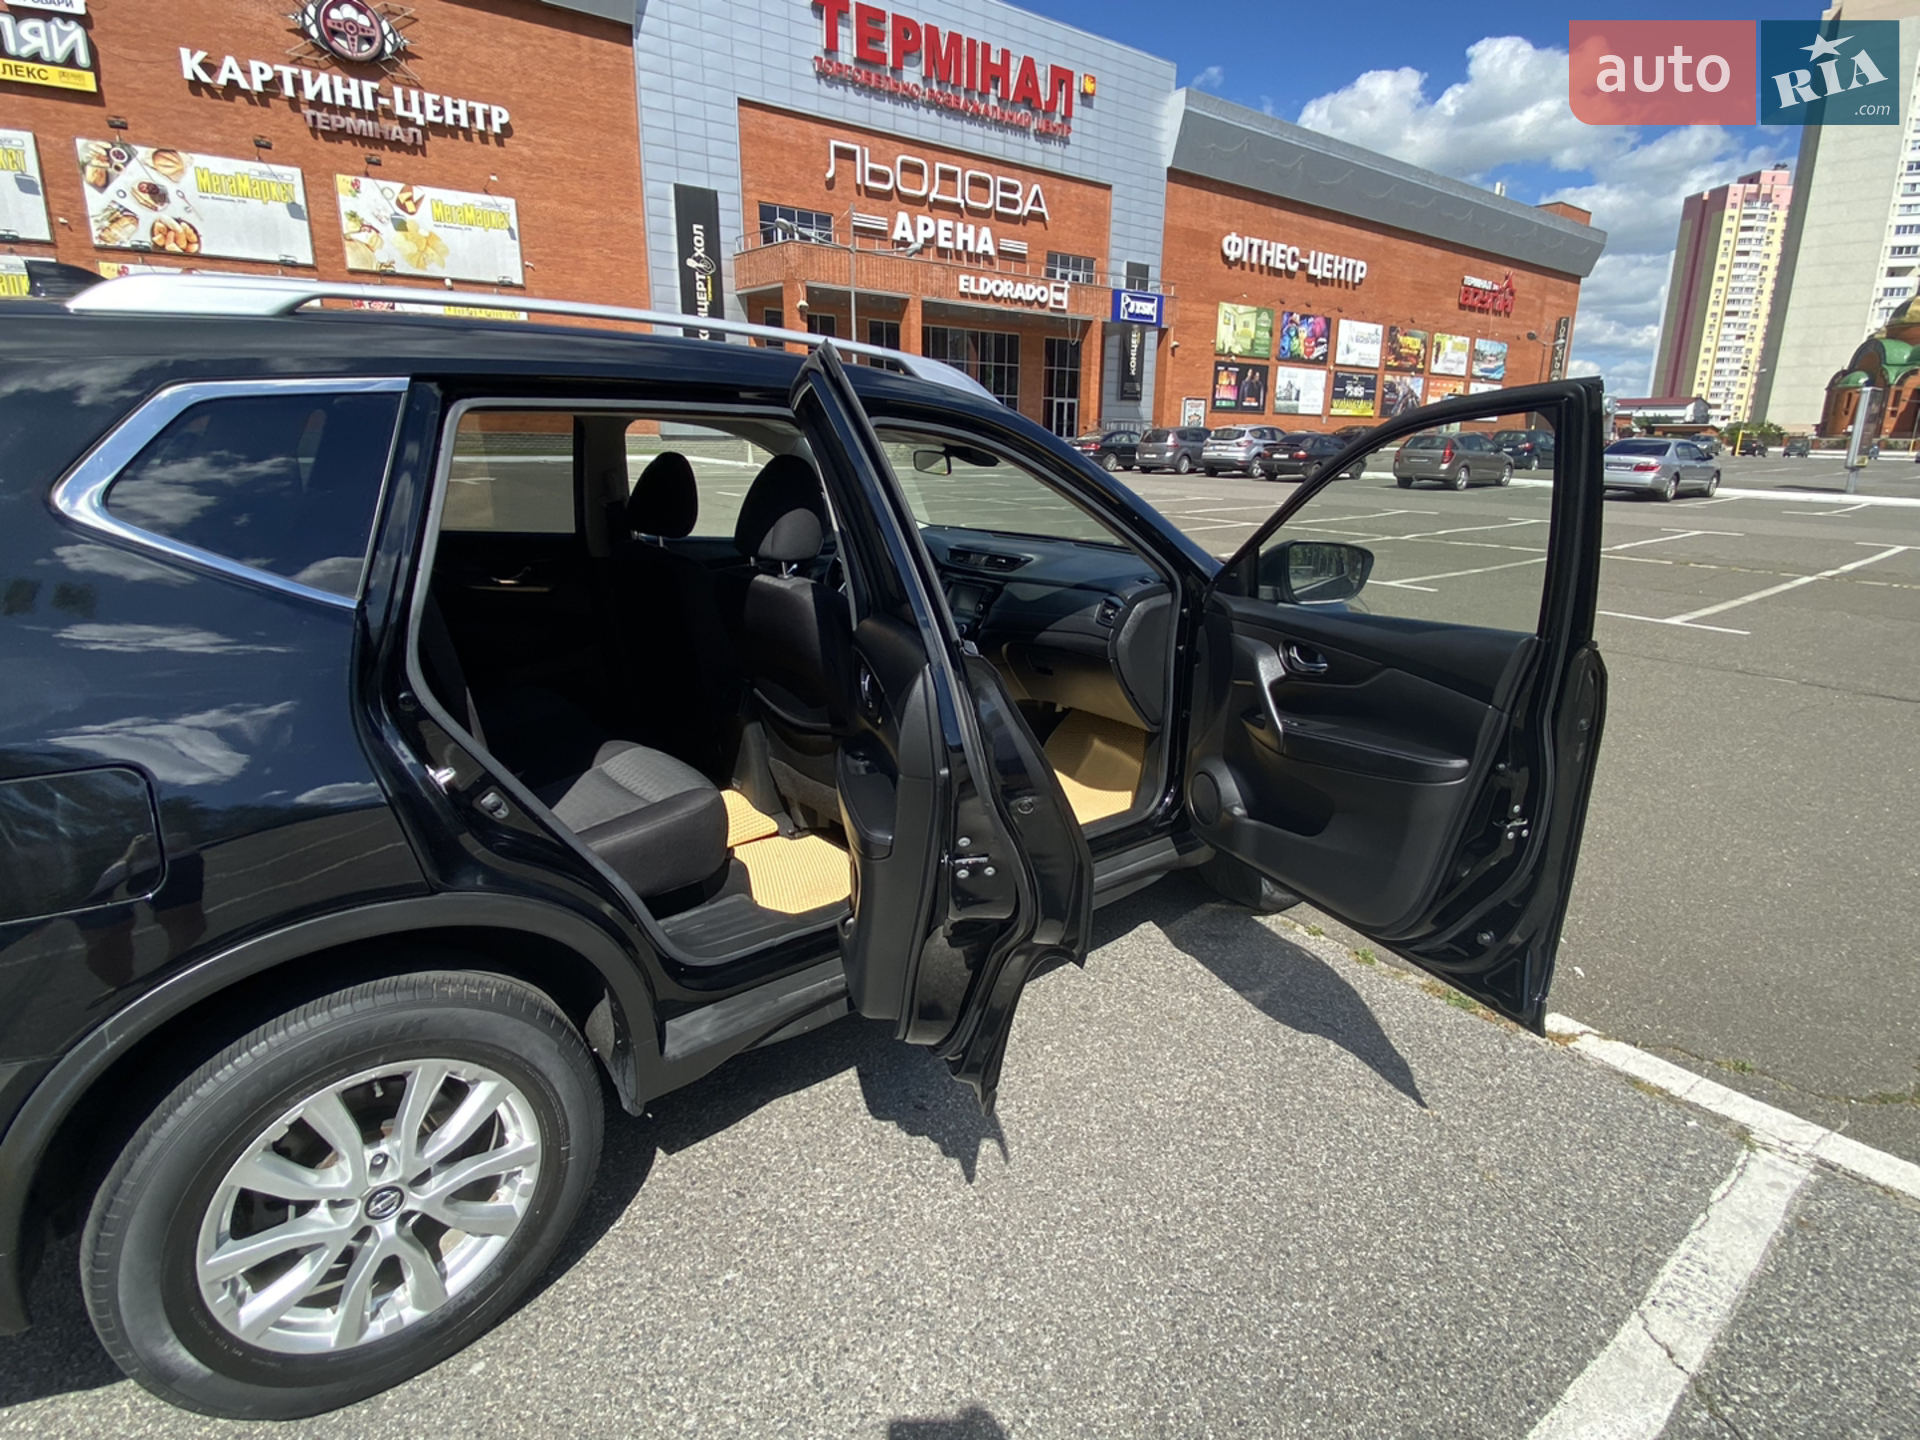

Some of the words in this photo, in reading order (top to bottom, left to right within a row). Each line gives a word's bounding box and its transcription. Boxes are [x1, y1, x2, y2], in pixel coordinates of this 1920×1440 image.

[1, 62, 49, 81] ЛЕКС
[812, 0, 1075, 118] ТЕРМІНАЛ
[179, 47, 510, 134] КАРТИНГ-ЦЕНТР
[302, 108, 422, 146] ТЕРМІНАЛ
[1034, 116, 1073, 137] ЦЕНТР
[194, 166, 296, 205] МегаМаркет
[825, 139, 1050, 221] ЛЬОДОВА
[430, 198, 511, 232] МегаМаркет
[892, 211, 996, 256] АРЕНА
[692, 223, 705, 258] ХОЛ
[1221, 231, 1368, 284] ФІТНЕС-ЦЕНТР
[958, 274, 1049, 303] ELDORADO
[1128, 300, 1156, 316] JYSK
